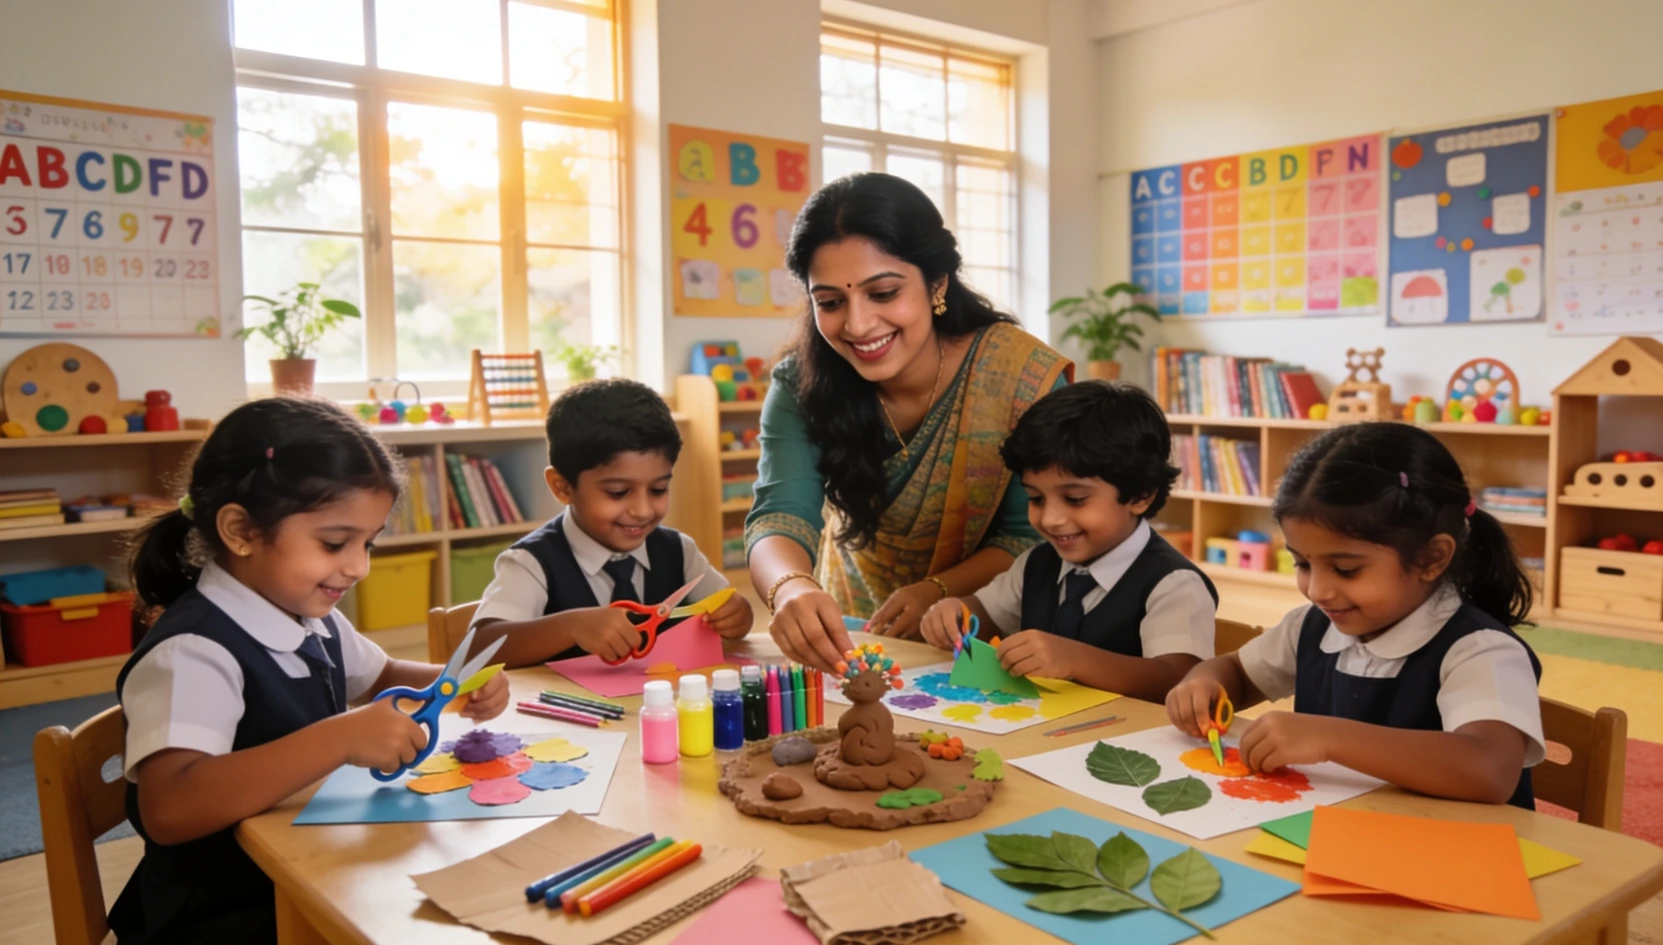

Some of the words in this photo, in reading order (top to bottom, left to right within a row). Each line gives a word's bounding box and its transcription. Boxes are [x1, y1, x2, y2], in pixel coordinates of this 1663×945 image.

[36, 146, 69, 189] B
[75, 150, 107, 192] C
[112, 153, 143, 194] D
[148, 158, 173, 197] F
[181, 161, 209, 200] D
[728, 141, 761, 186] B
[1158, 170, 1176, 195] C
[1188, 166, 1205, 191] C
[1214, 162, 1233, 188] C
[1249, 158, 1268, 186] B
[1279, 154, 1299, 181] D
[1348, 143, 1369, 173] N
[44, 208, 69, 239] 7
[83, 211, 104, 240] 6
[118, 212, 139, 243] 9
[152, 214, 174, 245] 7
[186, 217, 205, 246] 7
[683, 202, 713, 248] 4
[731, 203, 760, 249] 6
[3, 252, 32, 275] 17
[7, 290, 35, 311] 12
